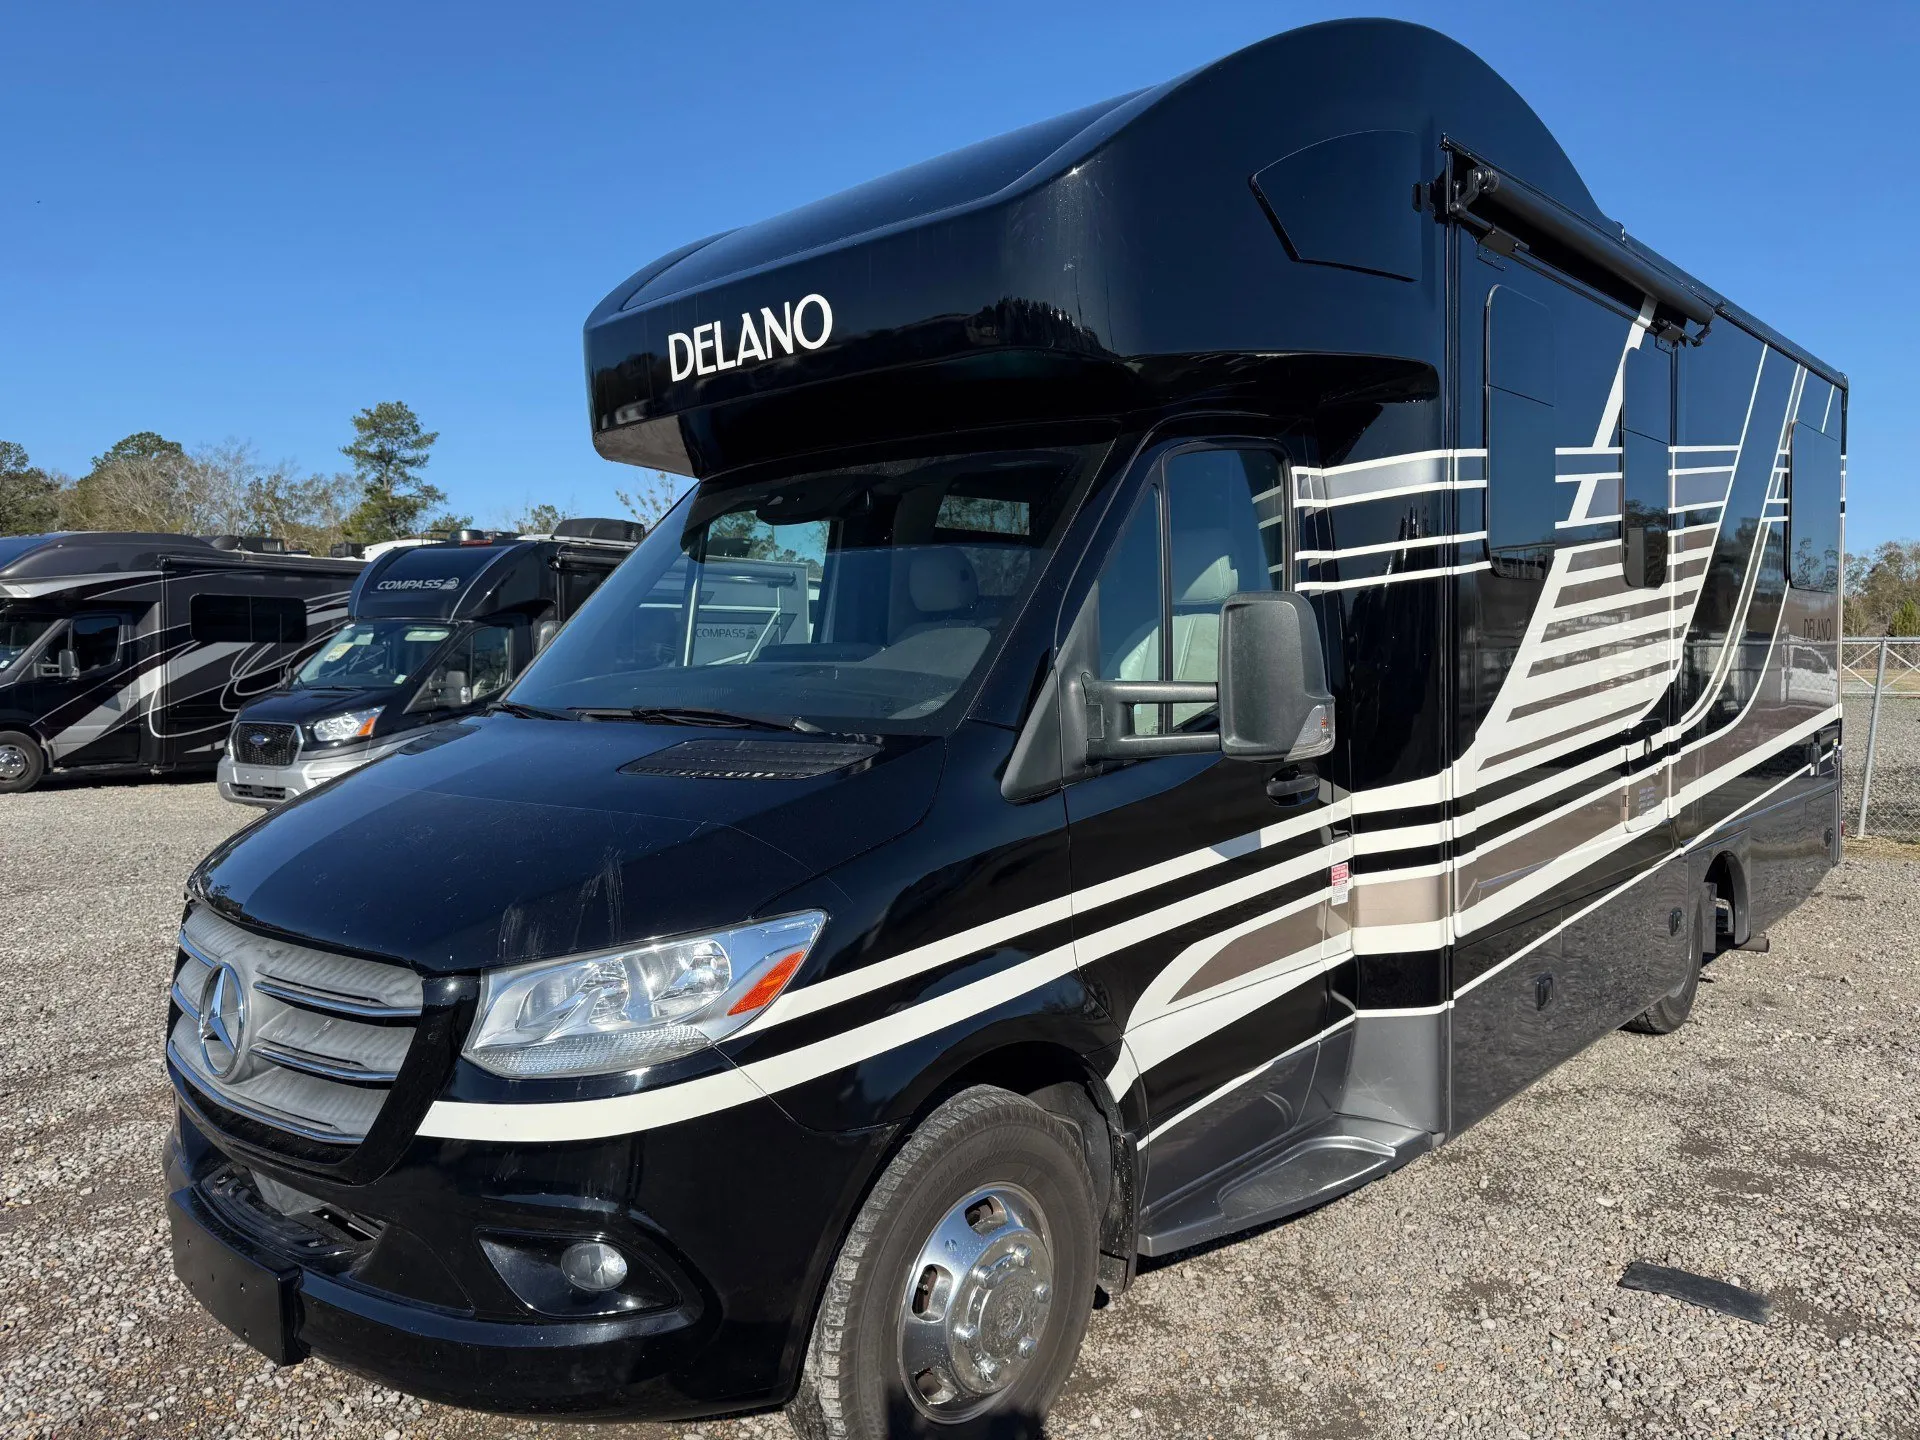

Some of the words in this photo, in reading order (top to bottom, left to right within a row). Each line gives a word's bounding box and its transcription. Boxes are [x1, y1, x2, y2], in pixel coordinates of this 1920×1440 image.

[668, 293, 833, 382] DELANO
[377, 579, 444, 590] COMPASS
[696, 628, 746, 639] COMPASS
[1803, 618, 1832, 642] DELANO
